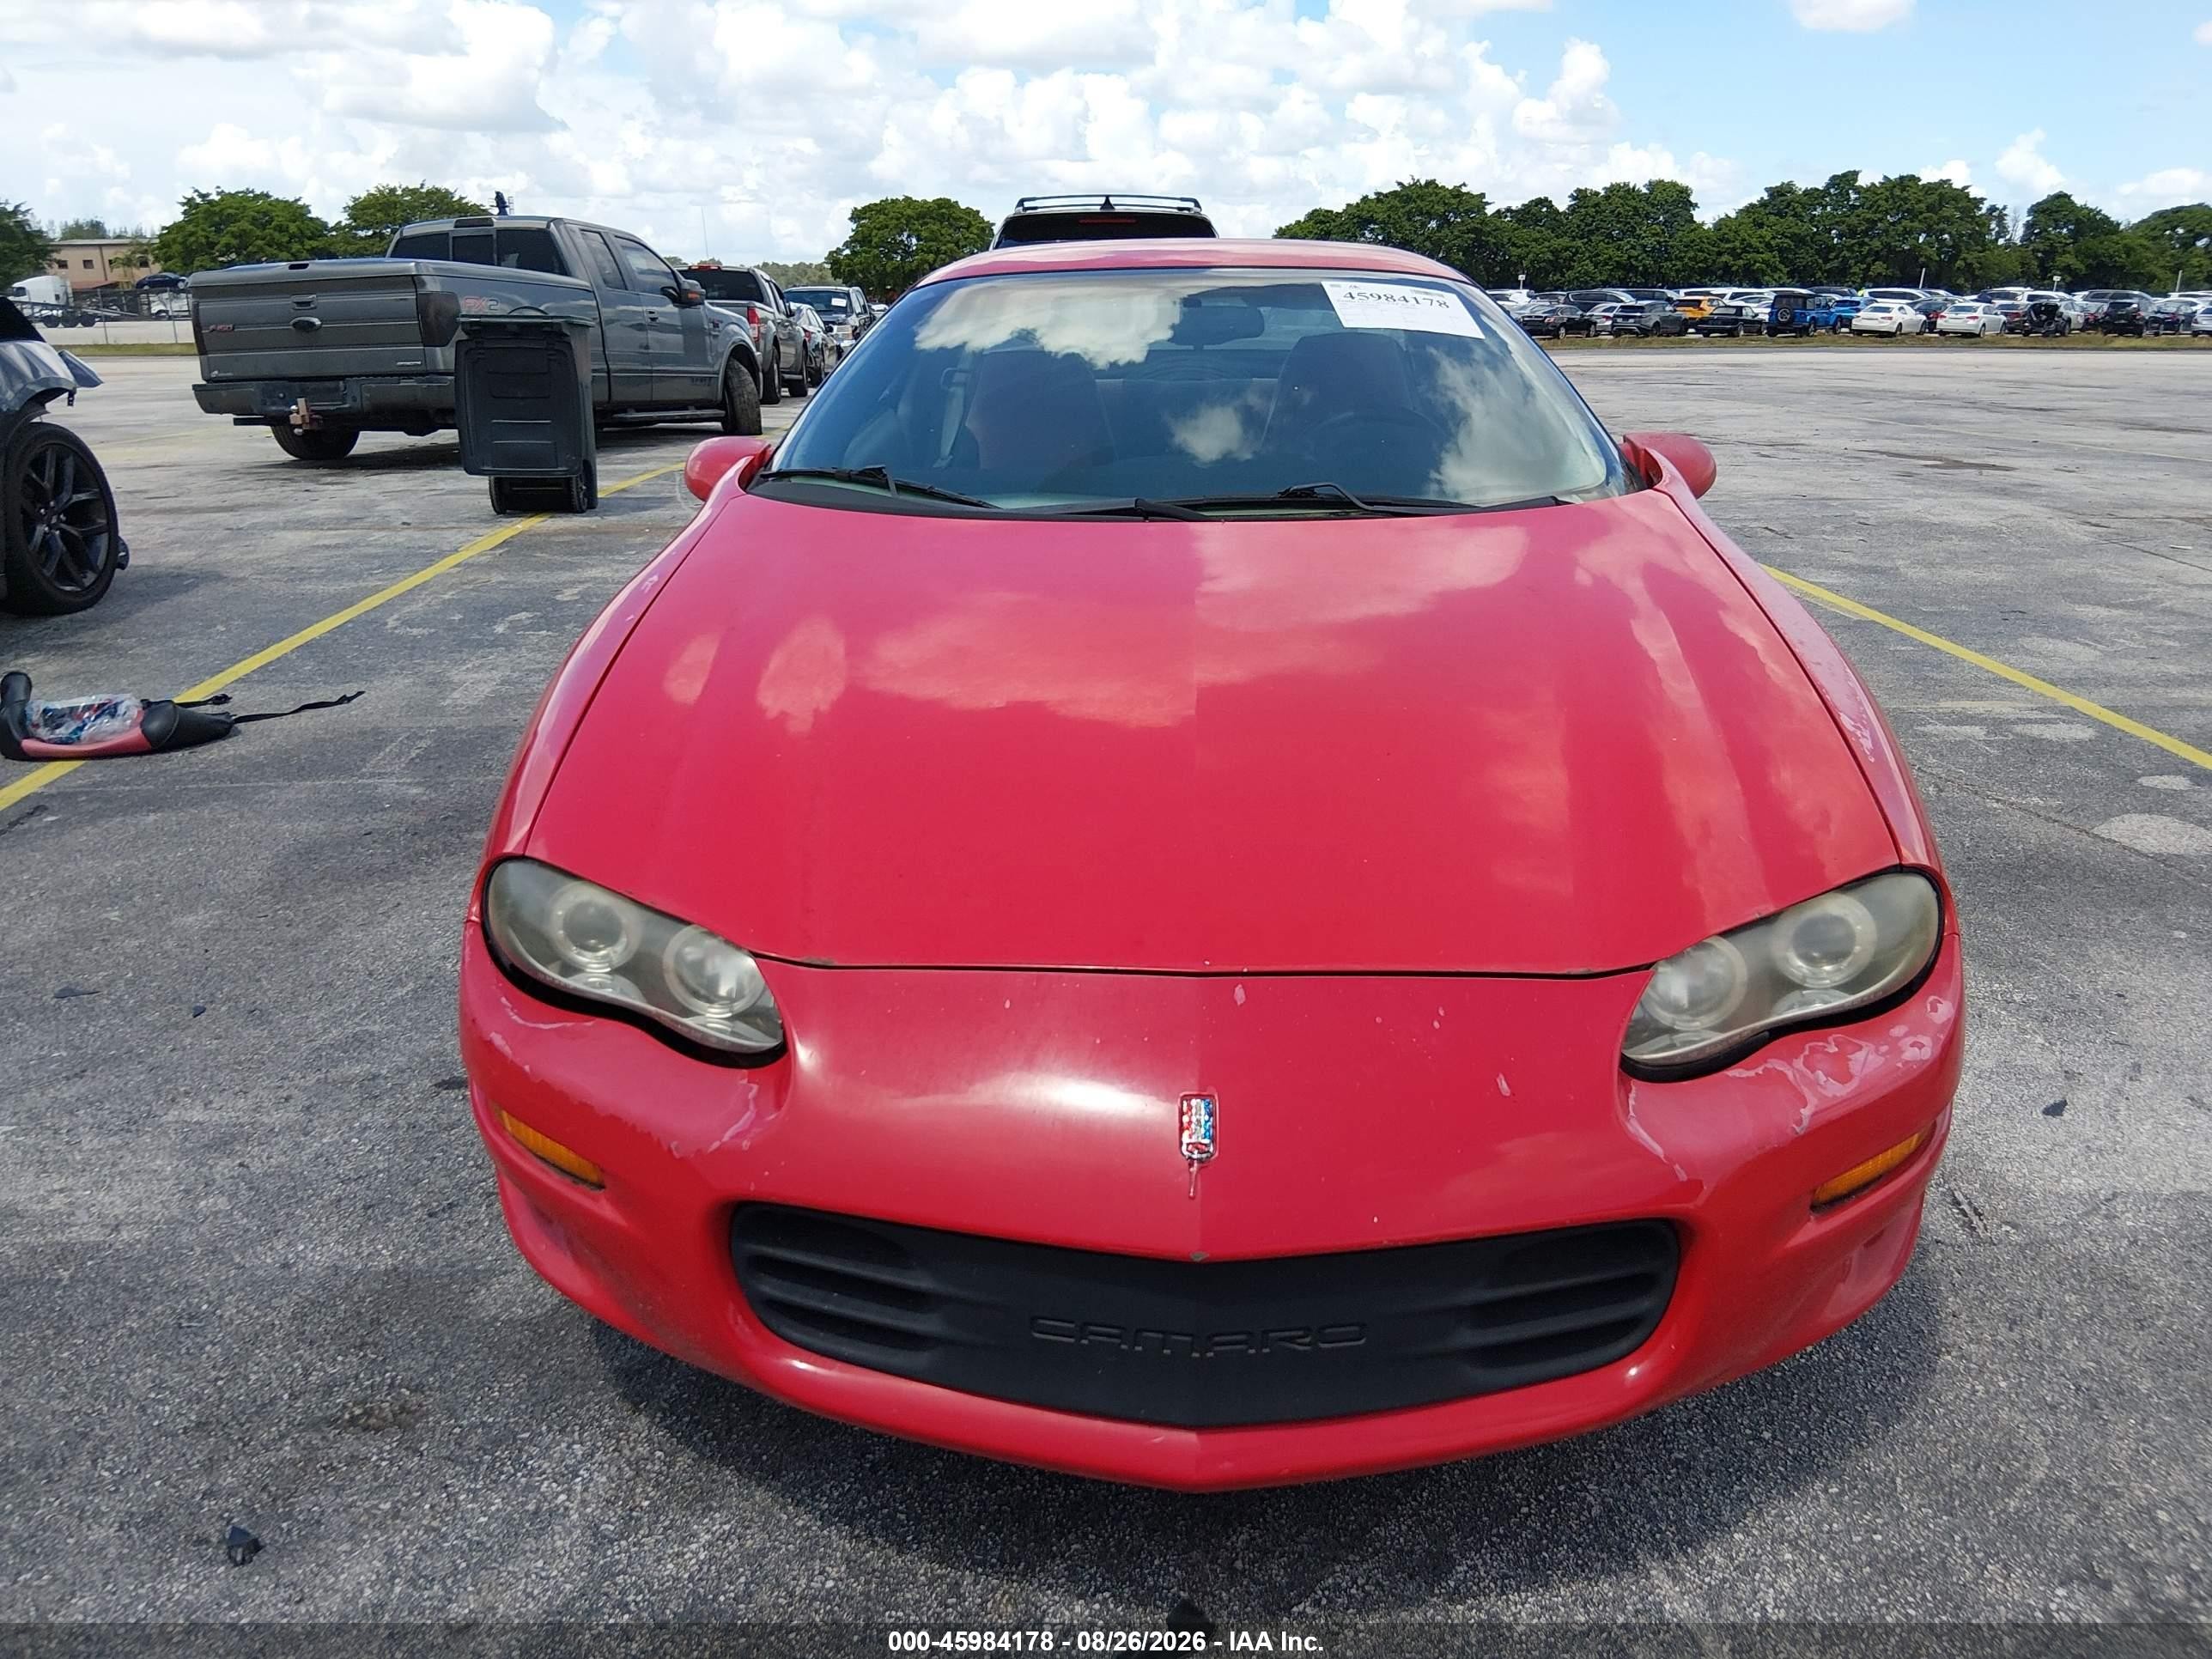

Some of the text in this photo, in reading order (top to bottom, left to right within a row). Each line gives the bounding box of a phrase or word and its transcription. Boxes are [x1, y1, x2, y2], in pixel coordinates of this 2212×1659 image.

[461, 295, 500, 312] FX2
[1342, 291, 1450, 309] 45984178
[1030, 1316, 1368, 1358] CAMARO
